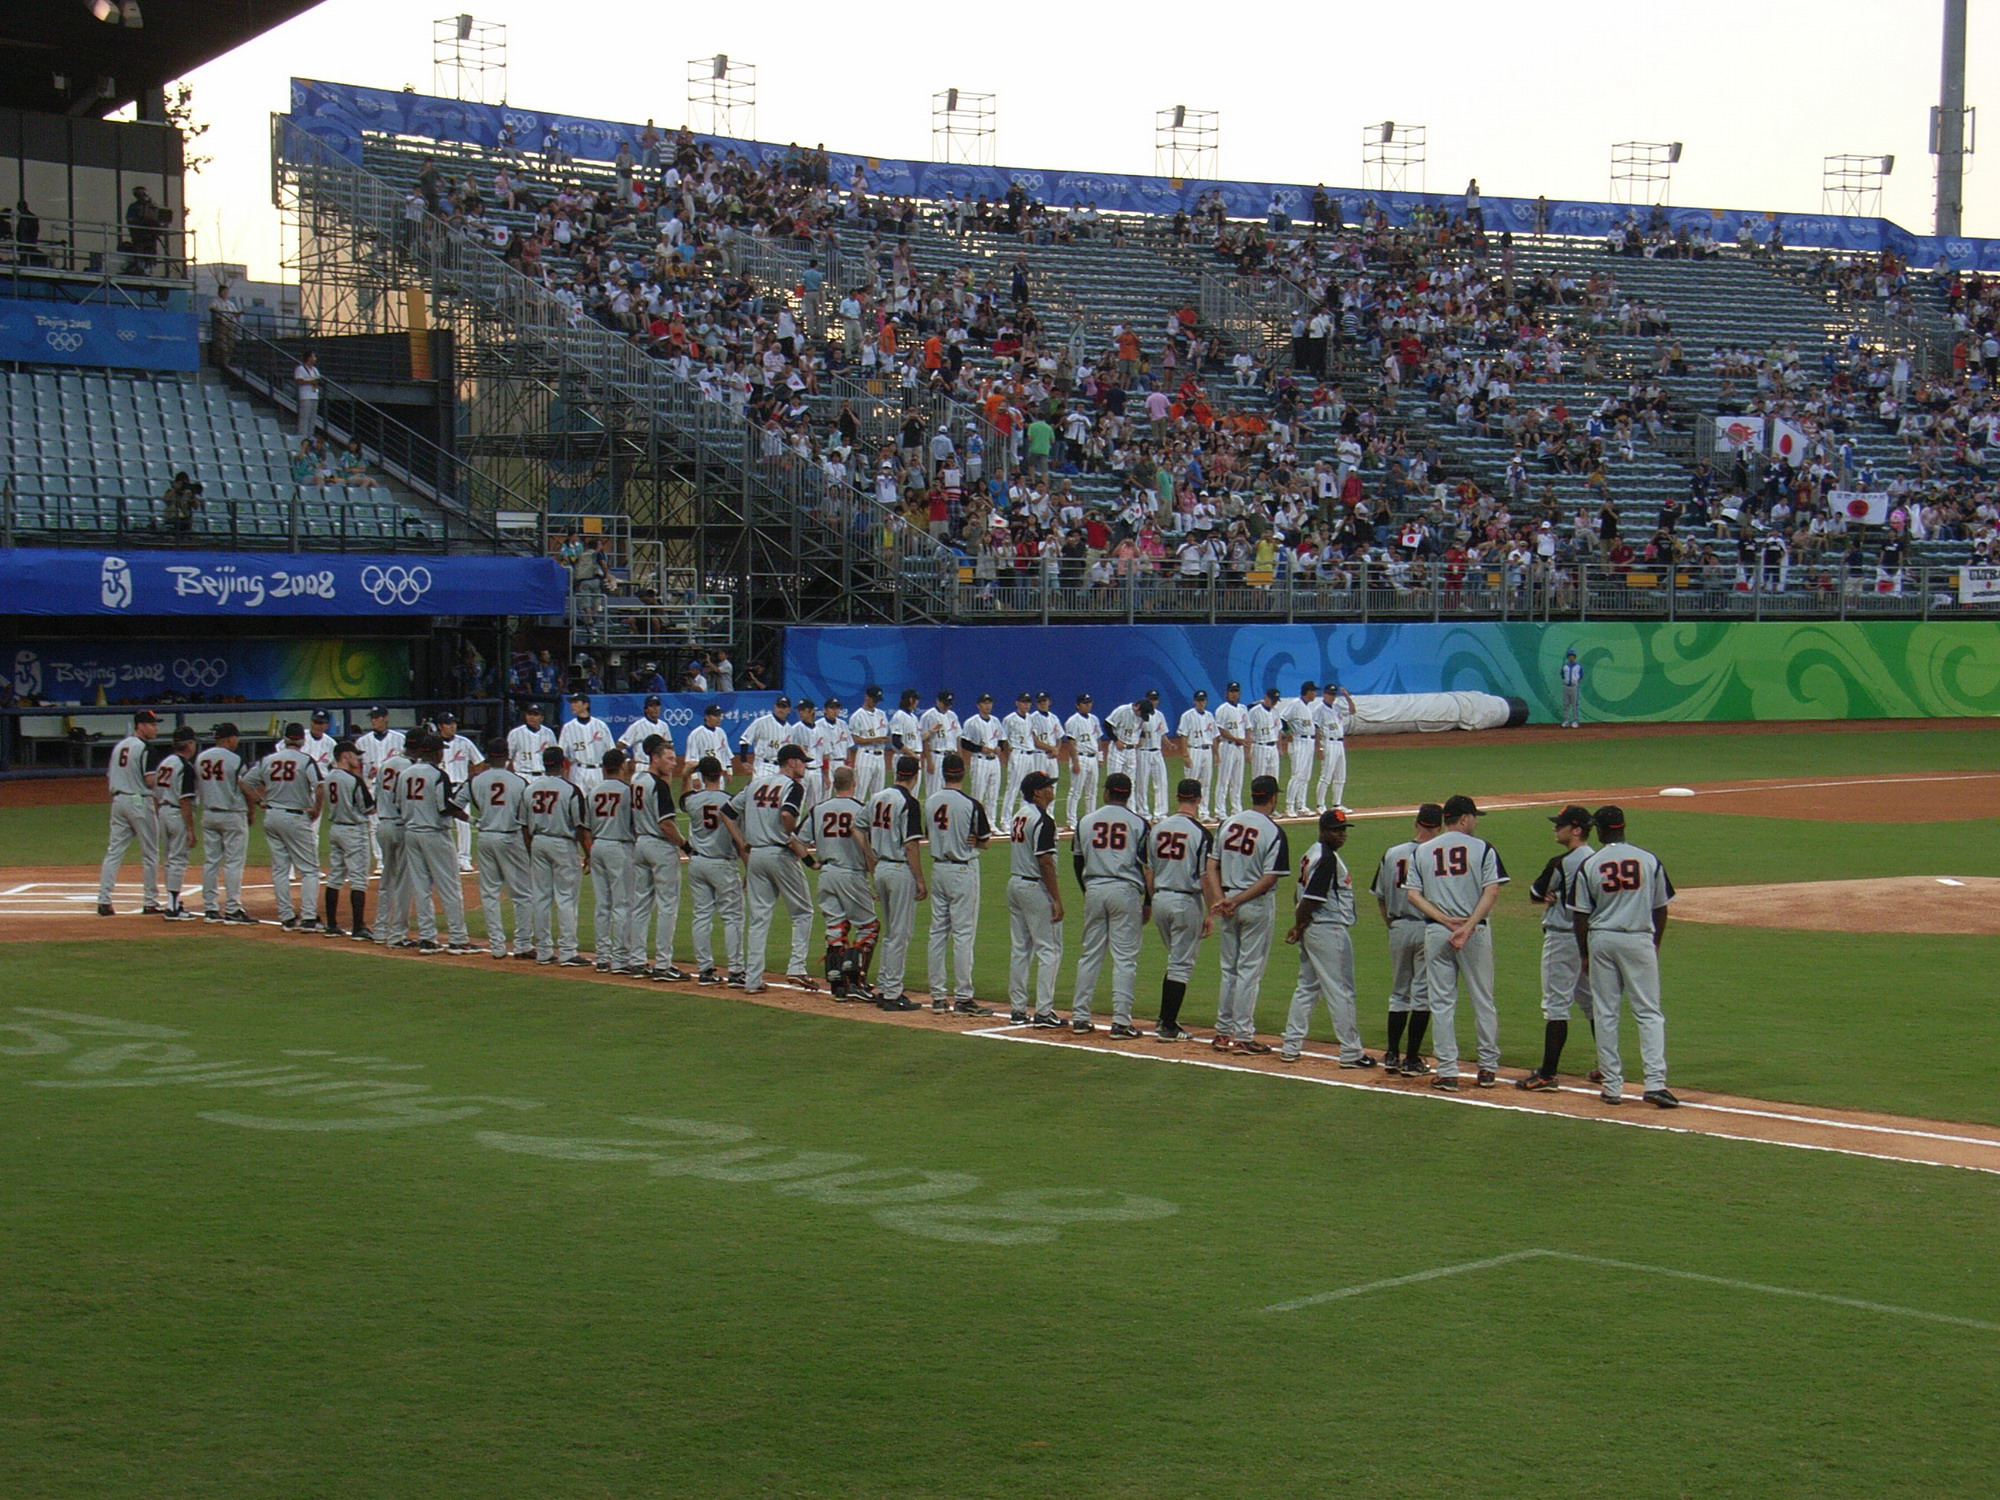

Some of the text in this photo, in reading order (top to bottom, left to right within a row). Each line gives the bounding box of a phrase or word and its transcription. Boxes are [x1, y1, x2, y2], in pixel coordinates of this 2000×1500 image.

[166, 565, 336, 607] Beijing 2008
[48, 661, 165, 689] Beijing 2008
[573, 742, 586, 752] 25
[768, 739, 780, 749] 46
[1080, 733, 1091, 743] 22
[119, 746, 131, 768] 6
[200, 758, 225, 782] 34
[520, 751, 533, 762] 31
[270, 760, 297, 783] 28
[329, 780, 339, 805] 8
[406, 777, 426, 801] 12
[490, 782, 507, 807] 2
[532, 790, 560, 815] 37
[630, 783, 644, 811] 18
[753, 784, 783, 809] 44
[594, 792, 622, 818] 27
[702, 804, 720, 831] 5
[872, 801, 892, 830] 14
[933, 803, 949, 830] 4
[822, 811, 852, 839] 29
[1011, 816, 1026, 844] 33
[1092, 821, 1128, 851] 36
[1156, 831, 1188, 861] 25
[1224, 823, 1259, 857] 26
[1433, 846, 1469, 878] 19
[1599, 858, 1642, 894] 39
[474, 1115, 1180, 1247] 2008
